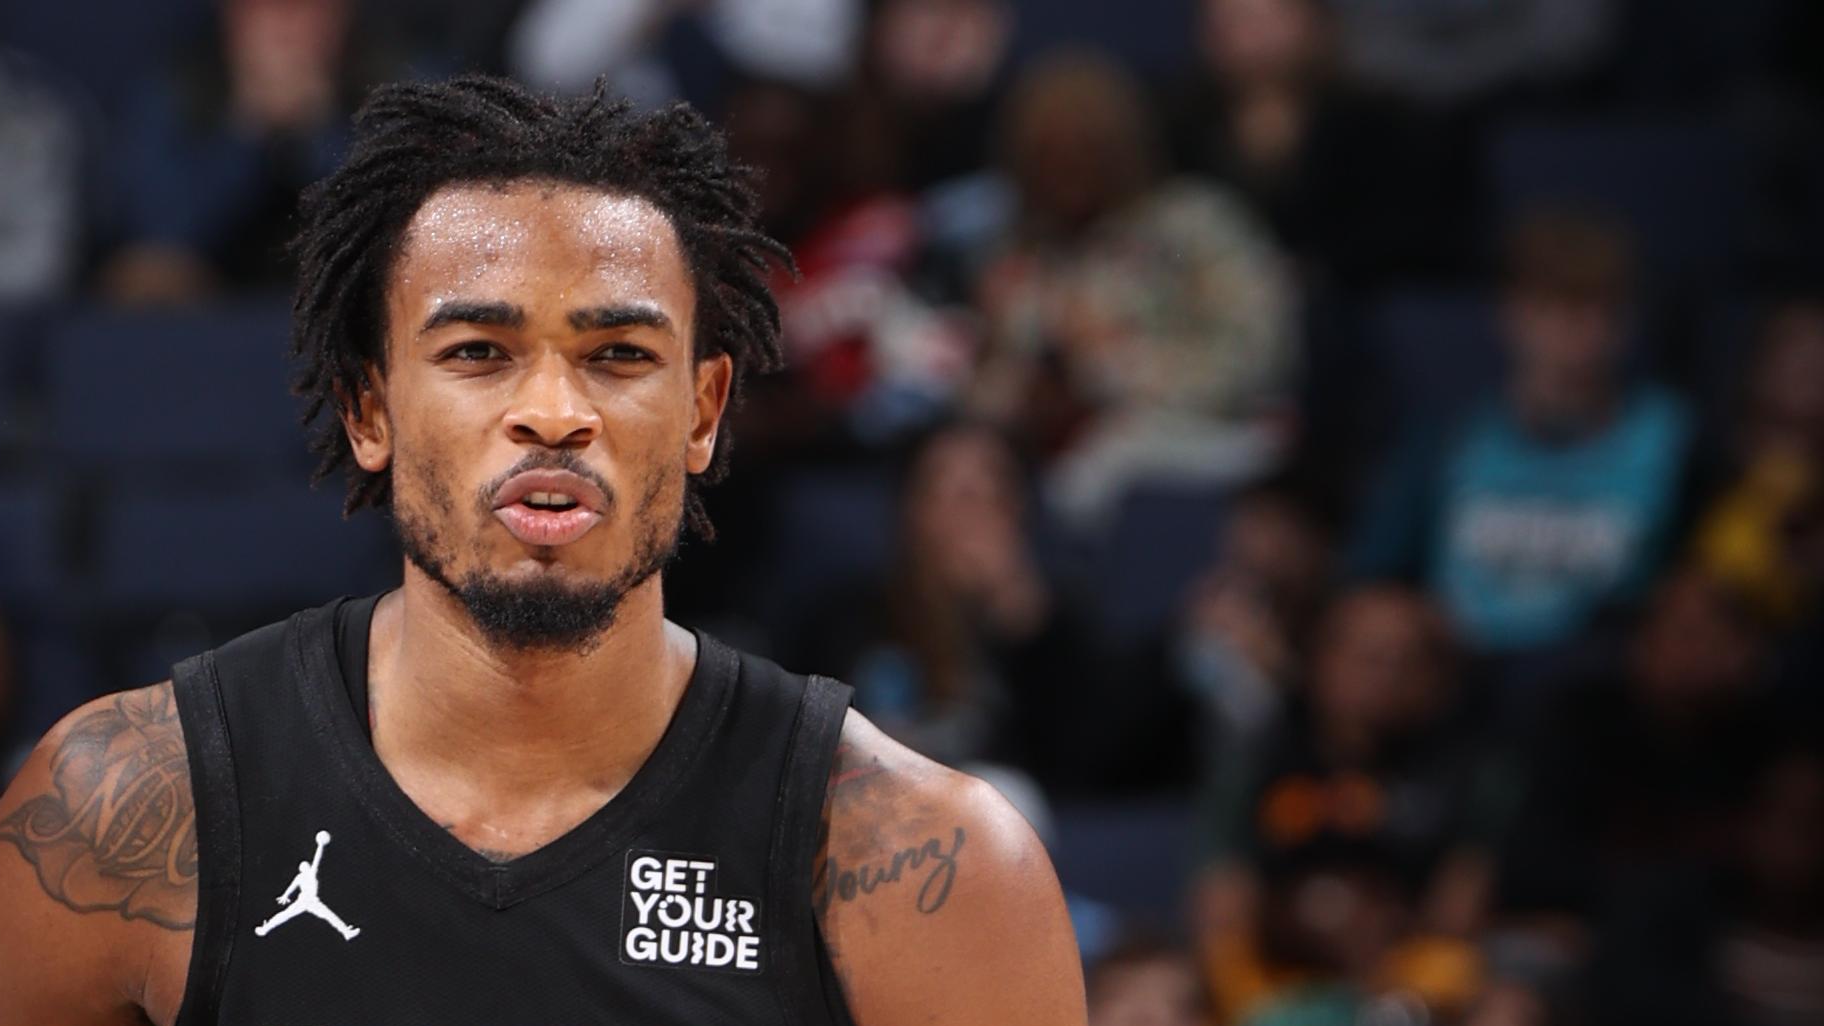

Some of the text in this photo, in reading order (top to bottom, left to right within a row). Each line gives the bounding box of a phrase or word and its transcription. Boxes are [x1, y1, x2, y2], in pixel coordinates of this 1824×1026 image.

[630, 856, 715, 893] GET
[630, 891, 755, 934] YOUR
[625, 927, 760, 970] GUIDE
